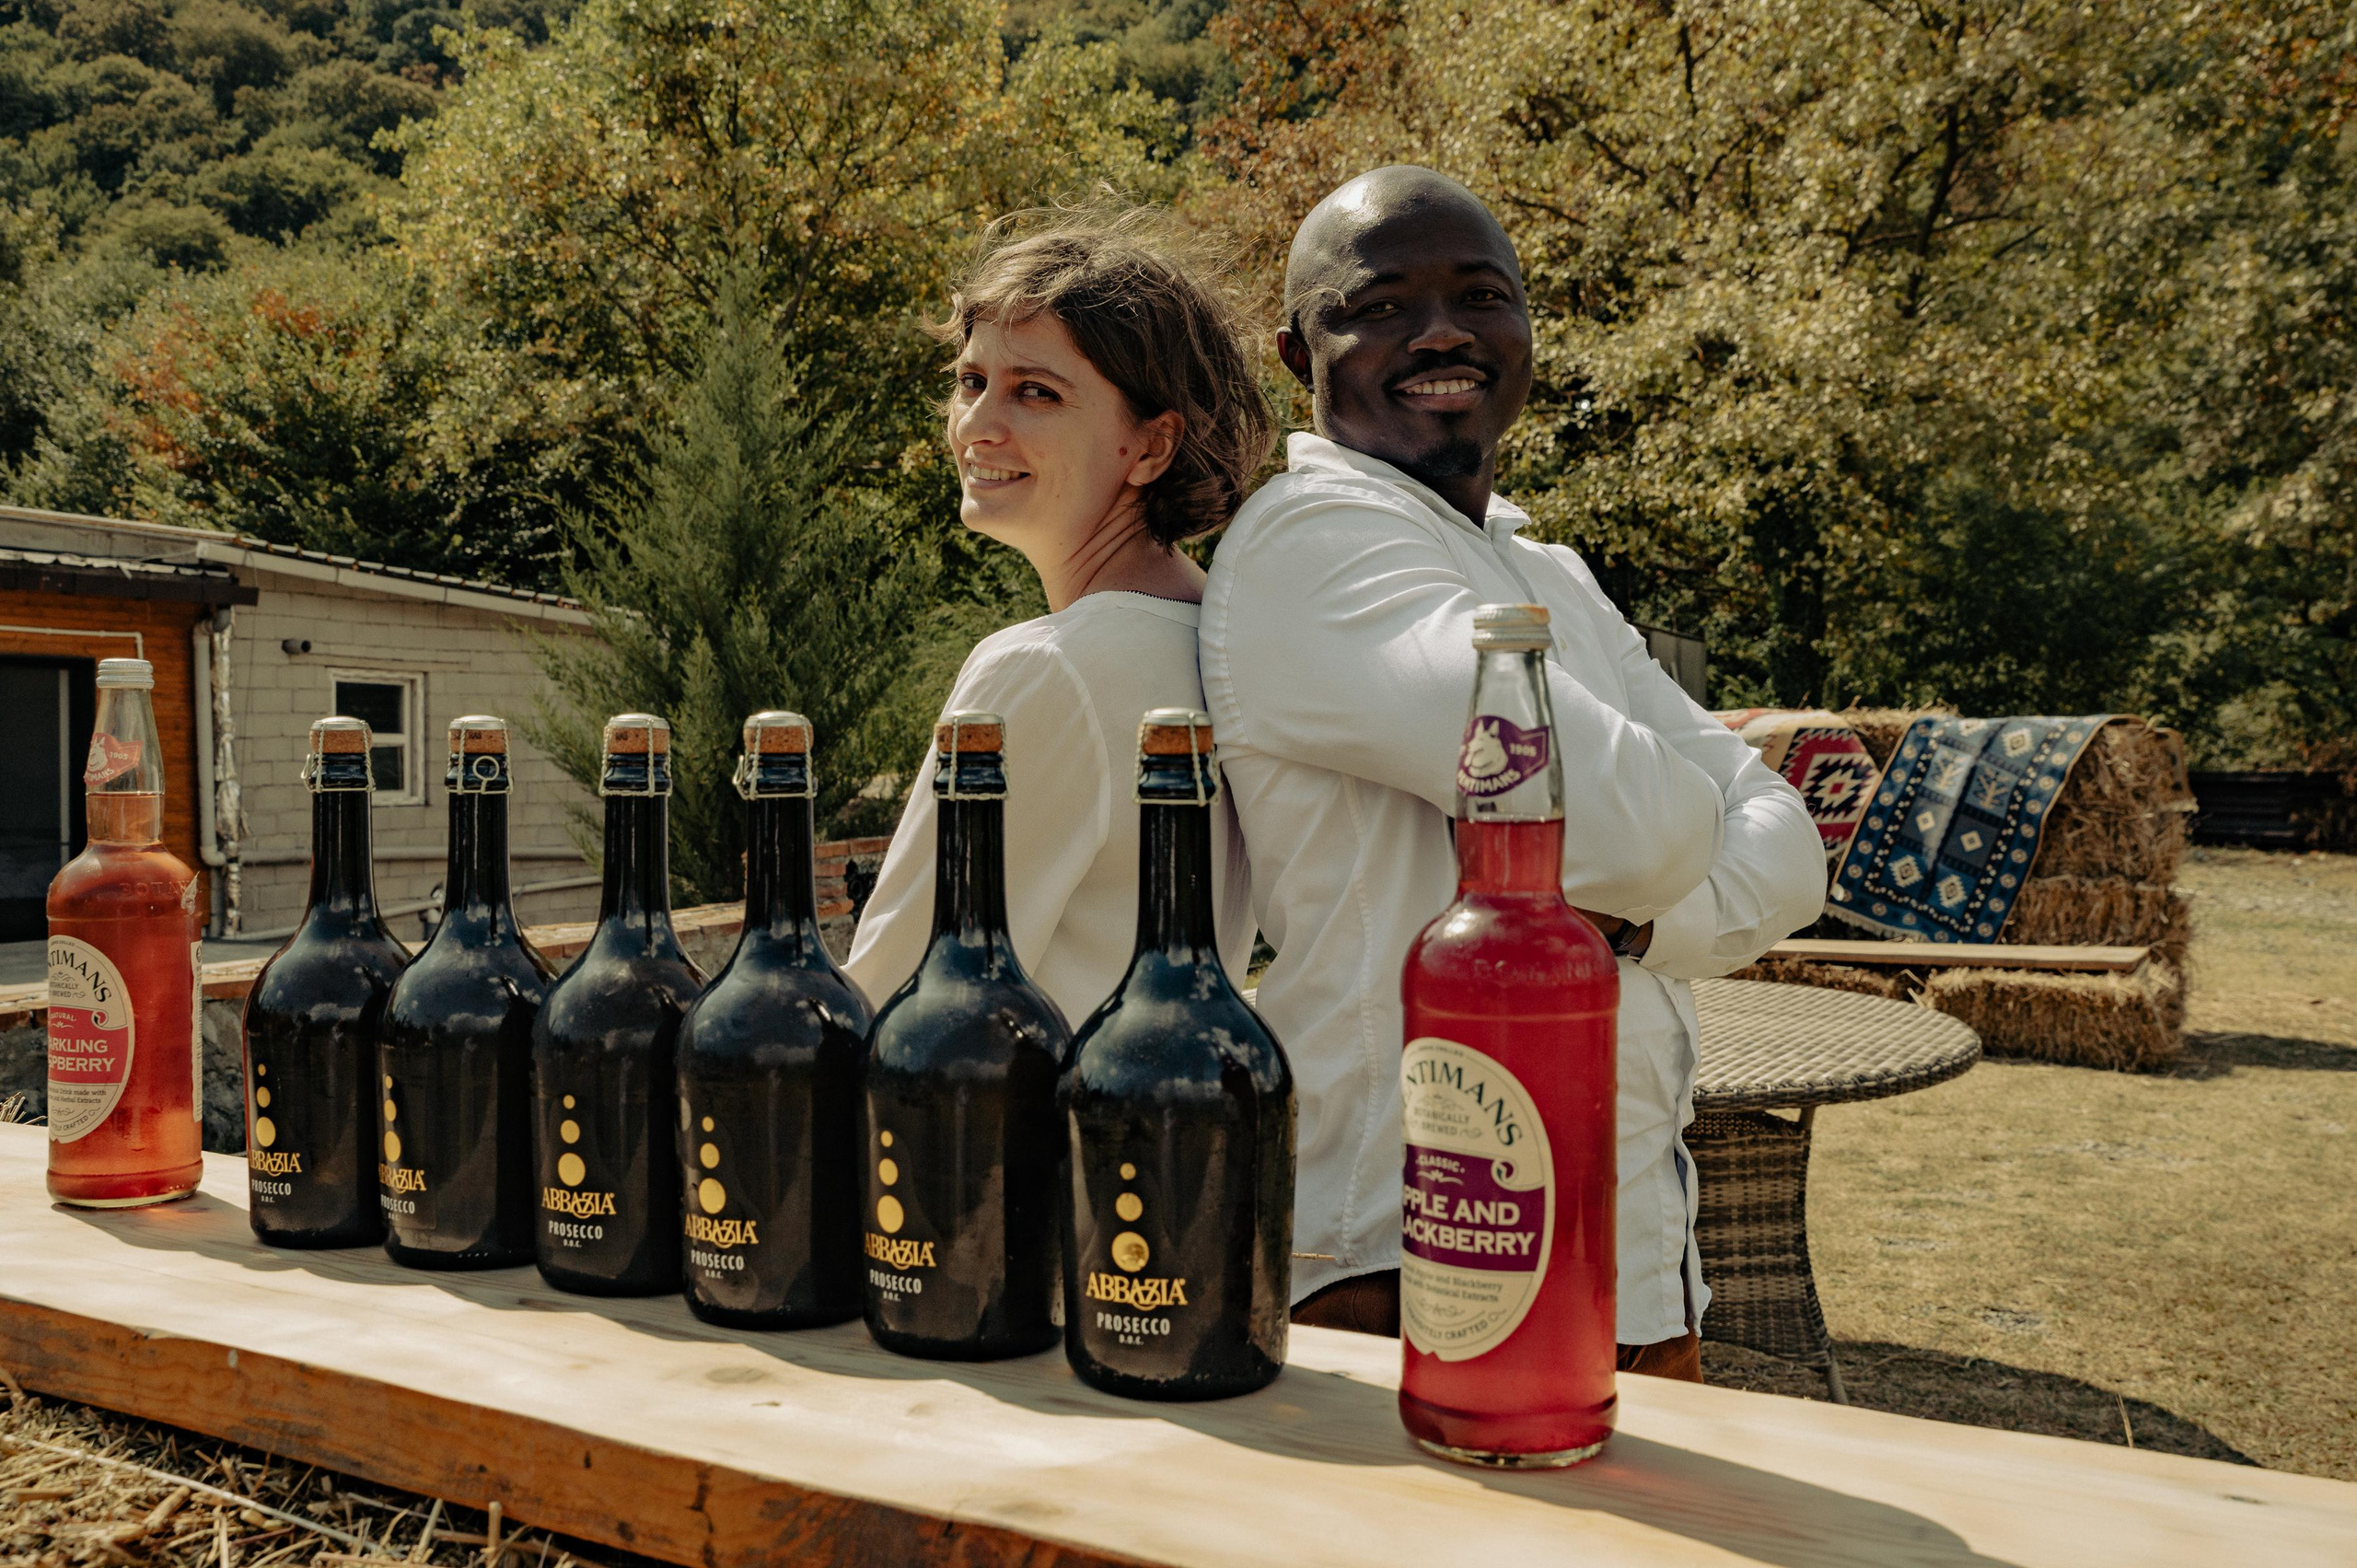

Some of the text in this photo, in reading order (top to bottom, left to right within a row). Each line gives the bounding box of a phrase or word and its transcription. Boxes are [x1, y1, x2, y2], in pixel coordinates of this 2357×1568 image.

[110, 751, 129, 761] 1905
[64, 1115, 89, 1131] CRAFTED
[251, 1179, 292, 1196] PROSECCO
[541, 1186, 617, 1219] ABBAZIA
[1453, 1199, 1520, 1225] AND
[549, 1220, 603, 1240] PROSECCO
[684, 1213, 760, 1249] ABBAZIA
[1402, 1214, 1536, 1255] ACKBERRY
[691, 1249, 745, 1271] PROSECCO
[865, 1231, 937, 1271] ABBAZIA
[869, 1268, 923, 1295] PROSECCO
[1086, 1272, 1189, 1311] ABBAZIA
[1097, 1311, 1170, 1336] PROSECCO
[1445, 1318, 1489, 1340] CRAFTED
